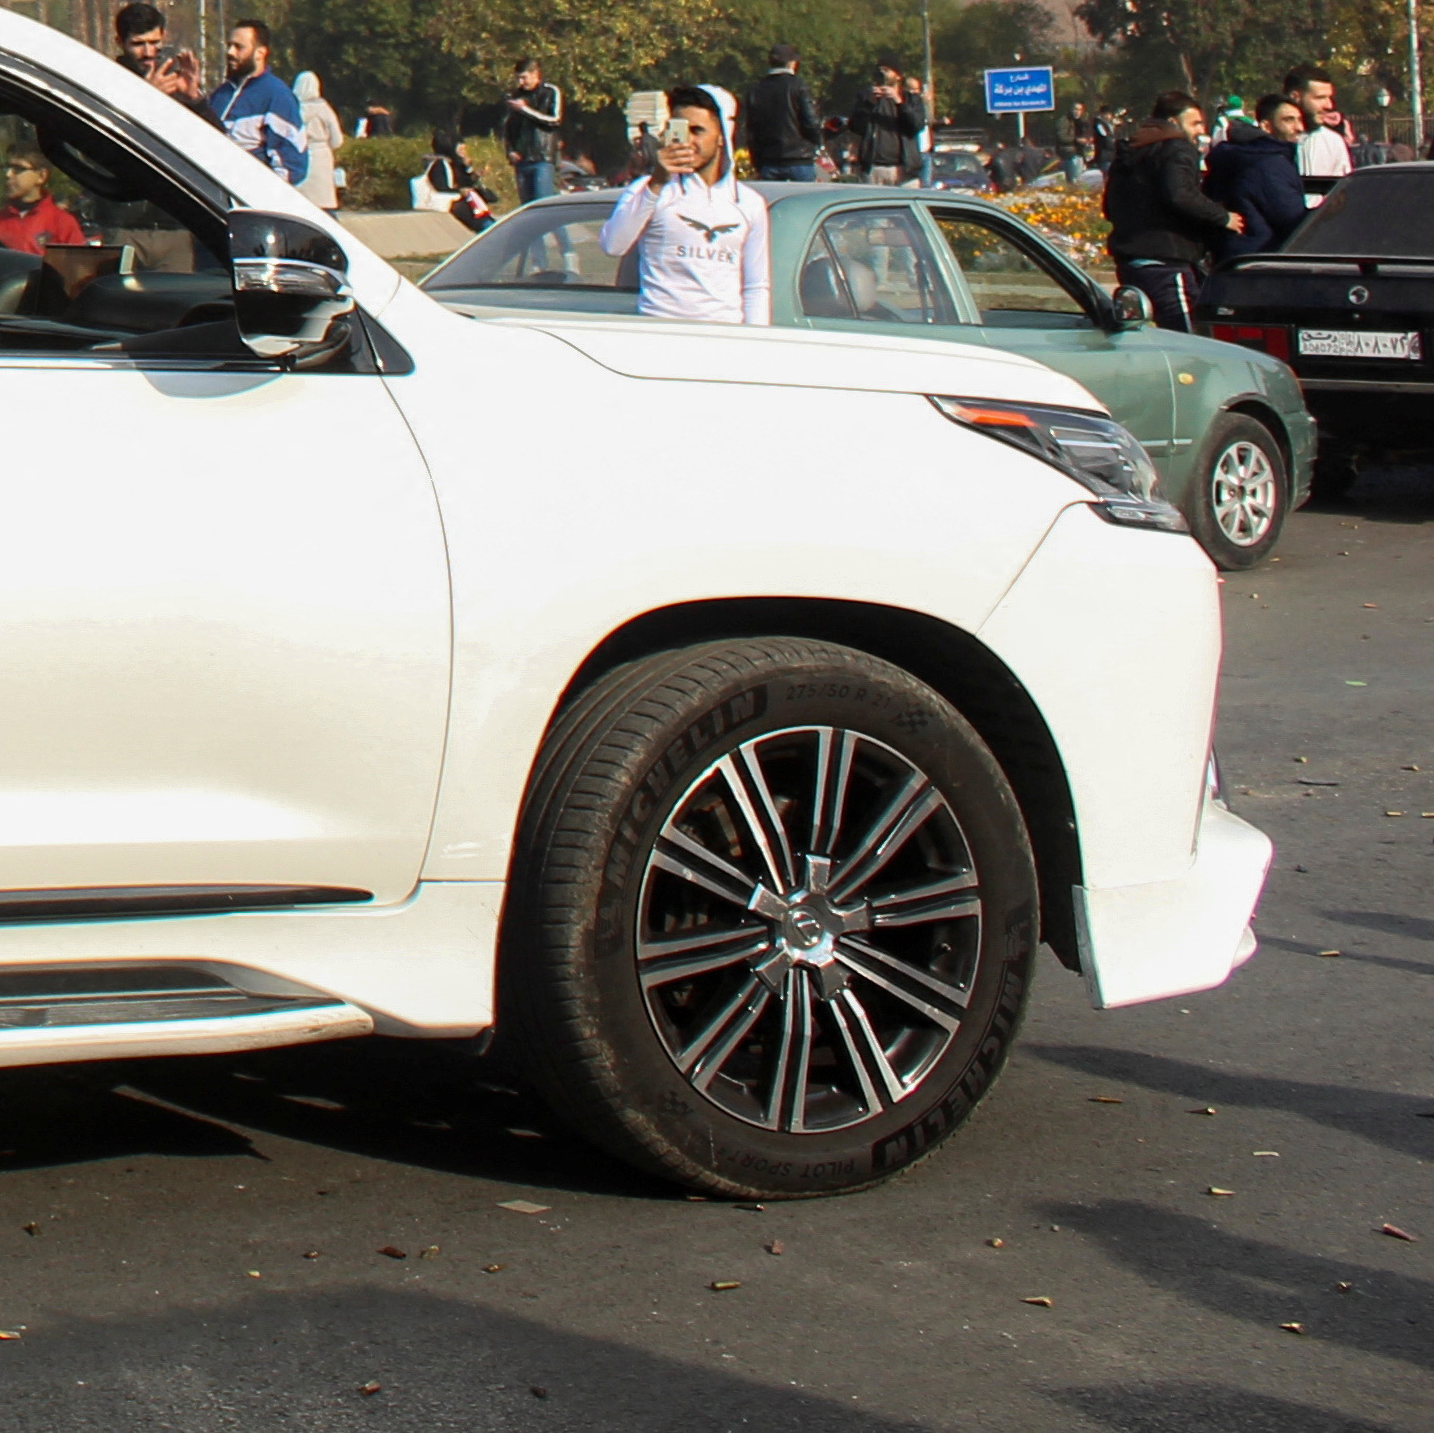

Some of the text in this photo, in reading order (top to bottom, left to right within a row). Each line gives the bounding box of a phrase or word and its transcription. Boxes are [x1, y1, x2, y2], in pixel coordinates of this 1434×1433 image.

[676, 245, 735, 264] SILVER
[785, 684, 849, 700] 275/50
[854, 687, 867, 701] R
[605, 689, 756, 890] MICHELIN
[885, 971, 1024, 1167] MICHELIN
[726, 1150, 792, 1177] SPORT
[799, 1159, 855, 1178] PILOT
